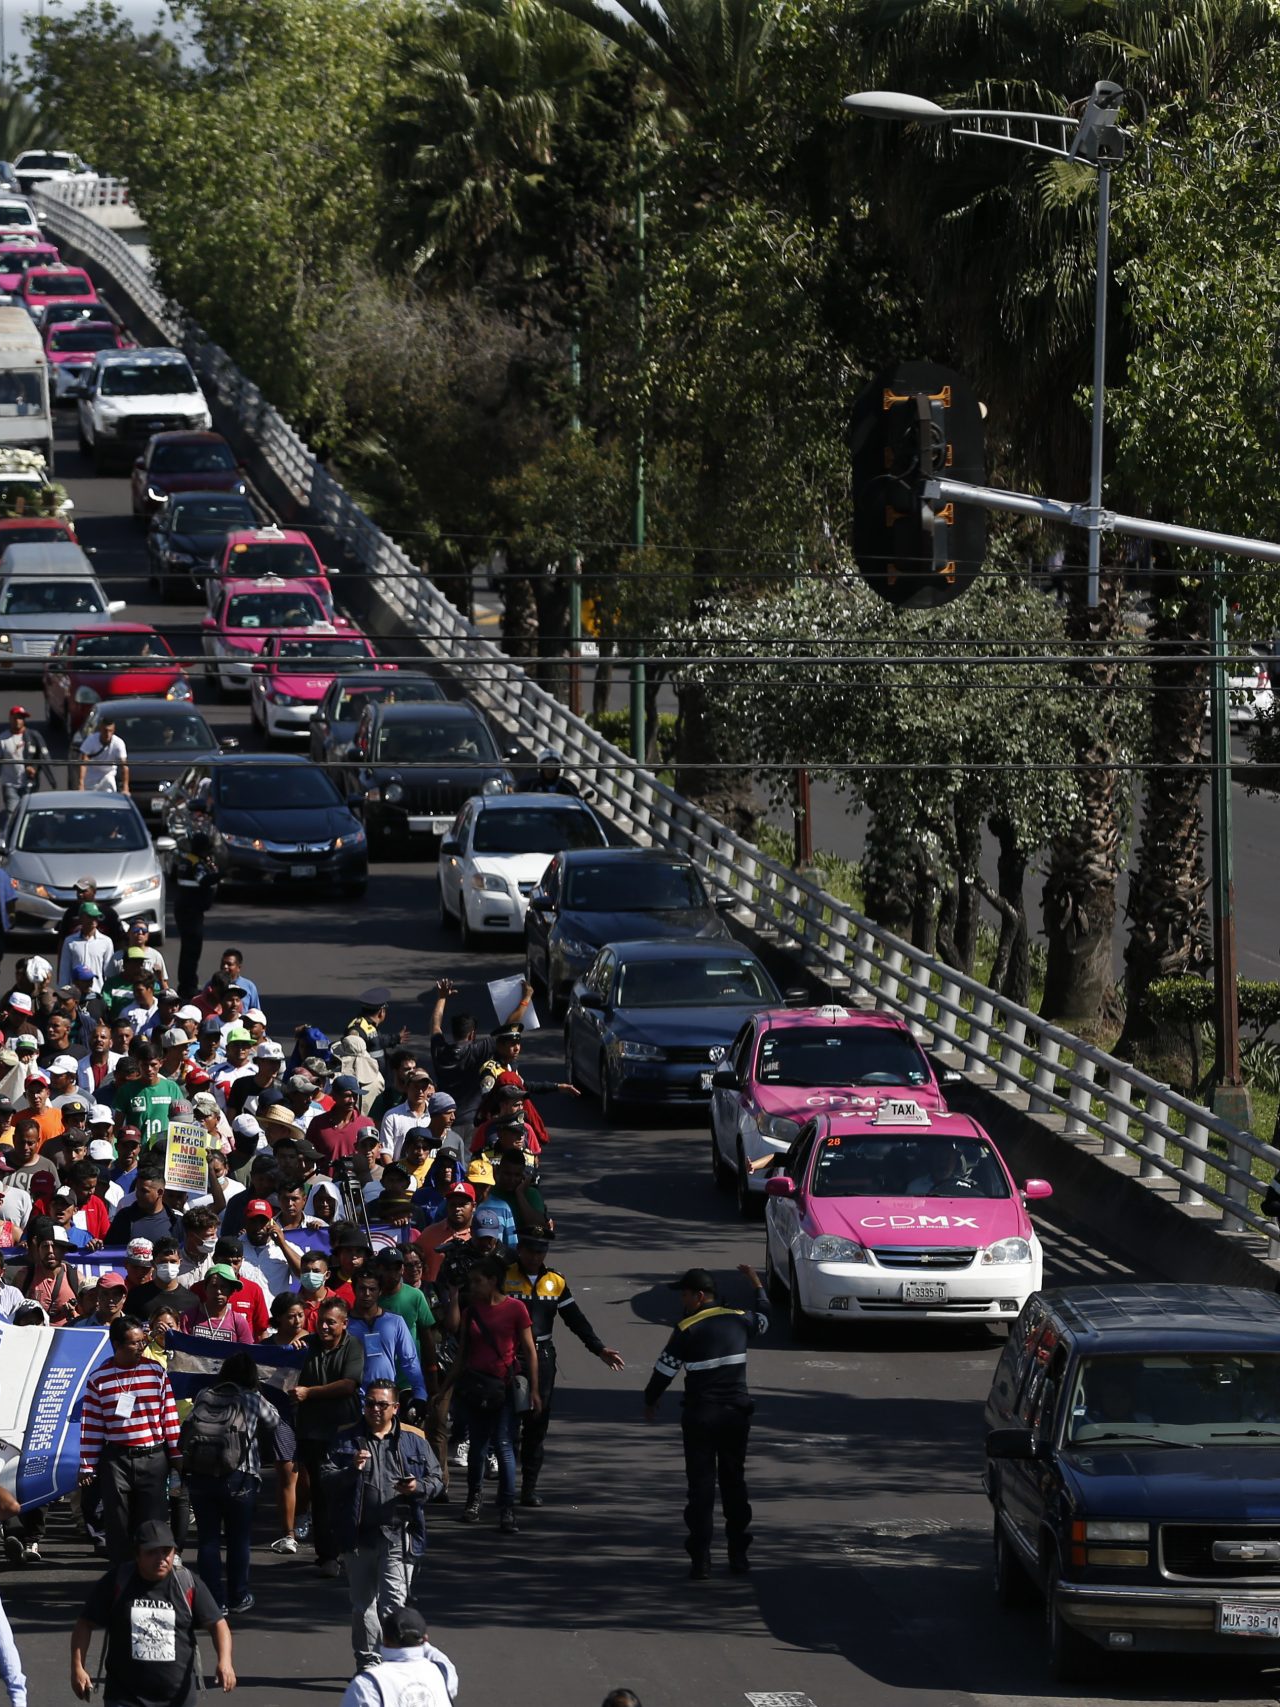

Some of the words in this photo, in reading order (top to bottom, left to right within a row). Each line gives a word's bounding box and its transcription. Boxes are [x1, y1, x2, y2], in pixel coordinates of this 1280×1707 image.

[891, 1104, 915, 1115] TAXI
[145, 1119, 162, 1141] 10
[173, 1126, 205, 1138] TRUMP
[173, 1135, 205, 1147] MEXICO
[827, 1138, 841, 1147] 28
[181, 1145, 197, 1155] NO
[860, 1215, 980, 1229] CDMX
[906, 1287, 944, 1298] A-3335-D
[28, 1367, 77, 1451] HONDURAS
[133, 1599, 174, 1610] ESTADO
[1222, 1612, 1279, 1629] MUX-38-14
